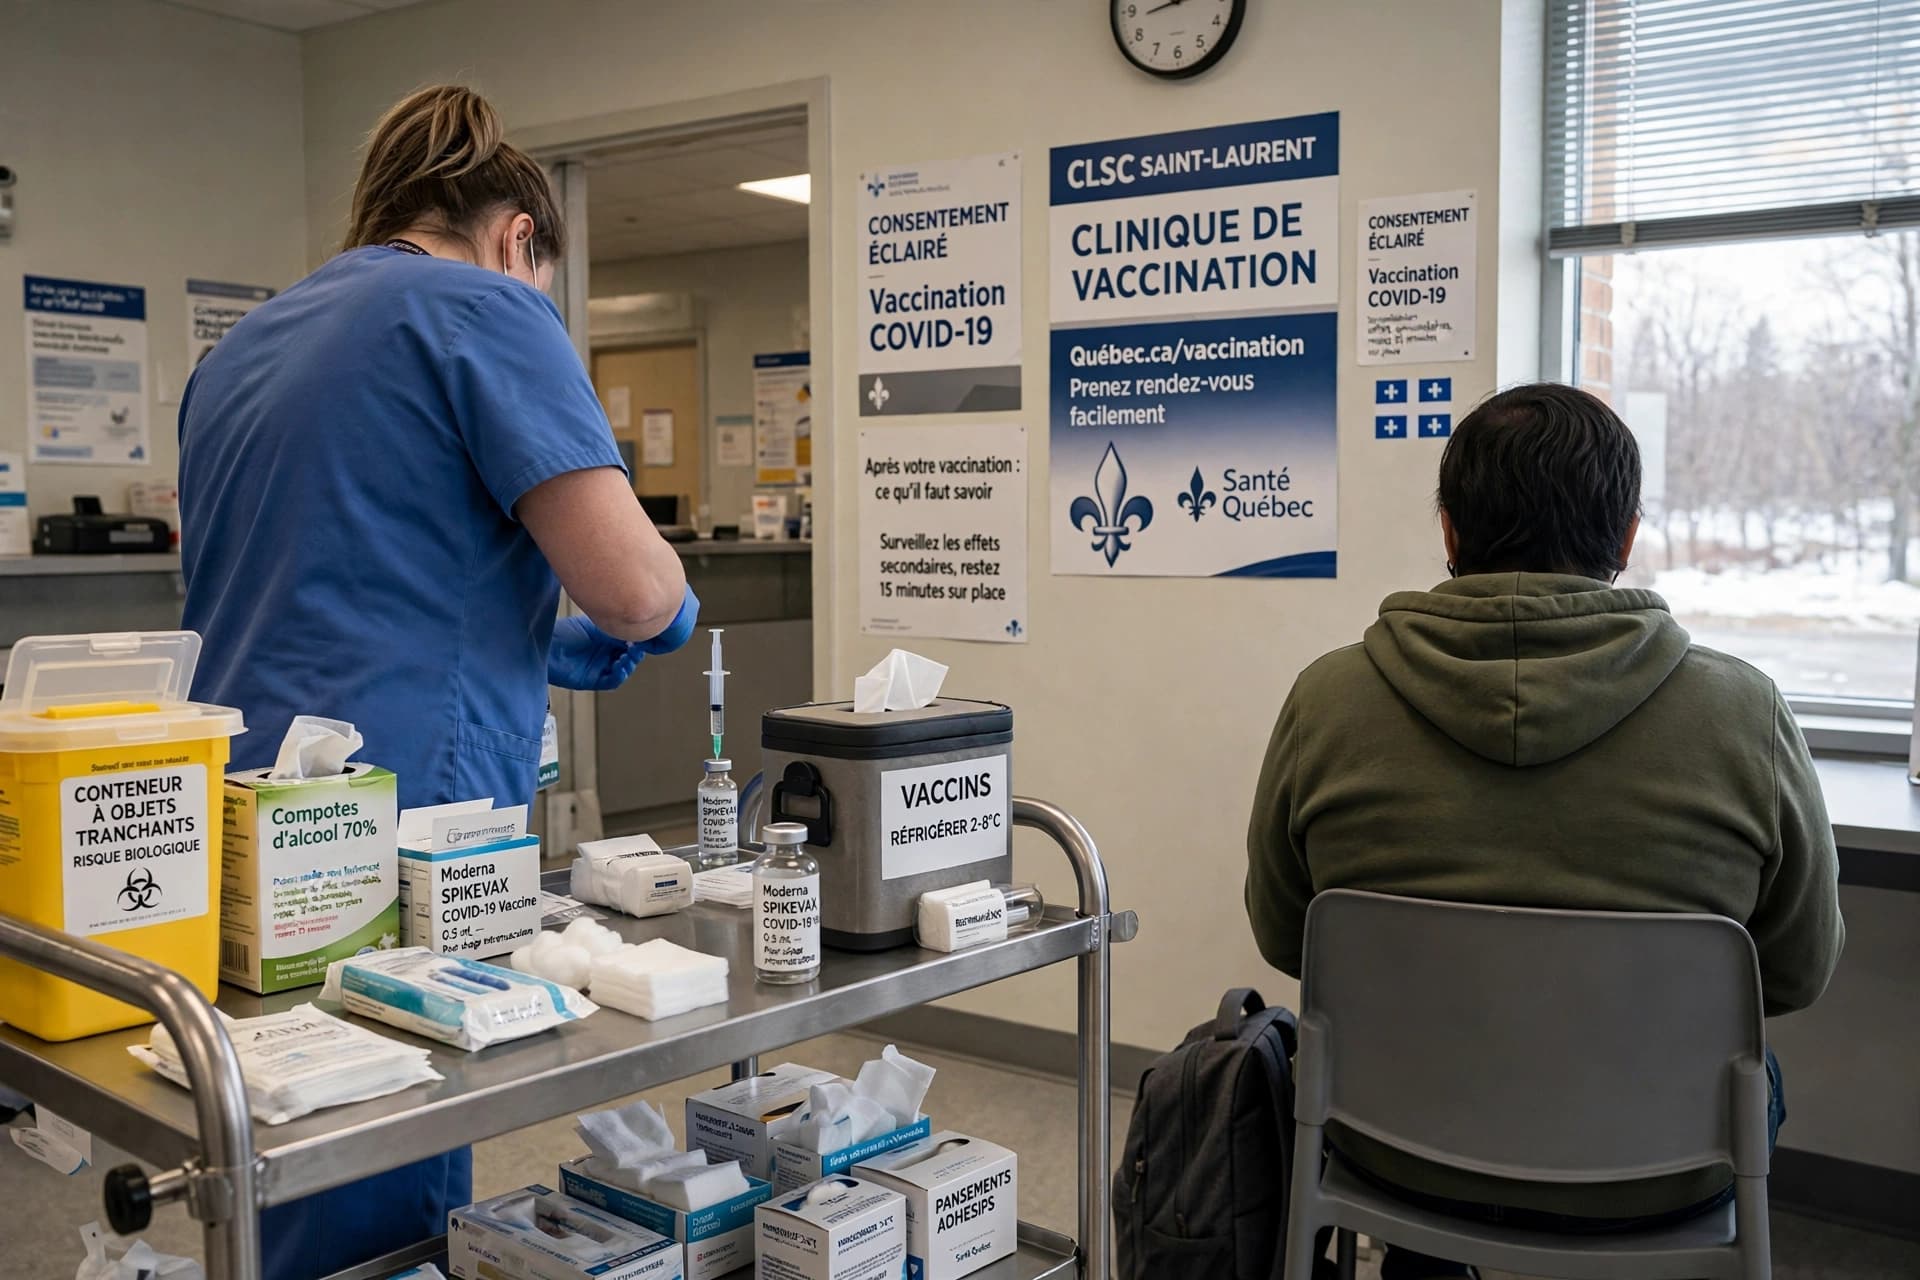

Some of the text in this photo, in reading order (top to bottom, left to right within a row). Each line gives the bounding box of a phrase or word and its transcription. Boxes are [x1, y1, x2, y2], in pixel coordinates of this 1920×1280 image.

[1128, 5, 1137, 18] 9
[1212, 14, 1221, 26] 4
[1135, 28, 1144, 42] 8
[1196, 34, 1205, 48] 5
[1152, 42, 1161, 56] 7
[1173, 45, 1182, 59] 6
[1067, 136, 1317, 189] CLSC SAINT-LAURENT
[868, 202, 1010, 236] CONSENTEMENT
[1071, 202, 1302, 257] CLINIQUE DE
[1368, 207, 1470, 230] CONSENTEMENT
[868, 233, 949, 265] ÉCLAIRÉ
[1368, 228, 1425, 251] ÉCLAIRÉ
[1071, 249, 1317, 302] VACCINATION
[1368, 264, 1459, 285] Vaccination
[869, 281, 1005, 315] Vaccination
[1368, 287, 1447, 307] COVID-19
[870, 315, 993, 352] COVID-19
[1069, 334, 1305, 367] Québec.ca/vaccination
[1069, 373, 1255, 398] Prenez rendez-vous
[1069, 404, 1166, 427] facilement
[865, 457, 901, 478] Après
[903, 458, 936, 475] votre
[939, 456, 1012, 474] vaccination
[1222, 466, 1290, 492] Santé
[875, 482, 993, 503] ce qu'il faut savoir
[1222, 495, 1314, 522] Québec
[880, 533, 1000, 551] Surveillez les effets
[880, 558, 1000, 576] secondaires, restez
[880, 582, 1006, 603] 15 minutes sur place
[74, 776, 183, 803] CONTENEUR
[901, 772, 991, 809] VACCINS
[92, 798, 176, 824] À OBJETS
[272, 802, 358, 825] Compotes
[75, 816, 195, 847] TRANCHANTS
[273, 819, 377, 849] d'alcool 70%
[891, 813, 1000, 846] RÉFRIGÉRER 2-8°C
[73, 839, 200, 868] RISQUE BIOLOGIQUE
[441, 863, 495, 883] Moderna
[441, 877, 509, 904] SPIKEVAX
[763, 884, 808, 897] Moderna
[442, 901, 496, 924] COVID-19
[763, 897, 818, 914] SPIKEVAX
[935, 1168, 1011, 1214] PANSEMENTS
